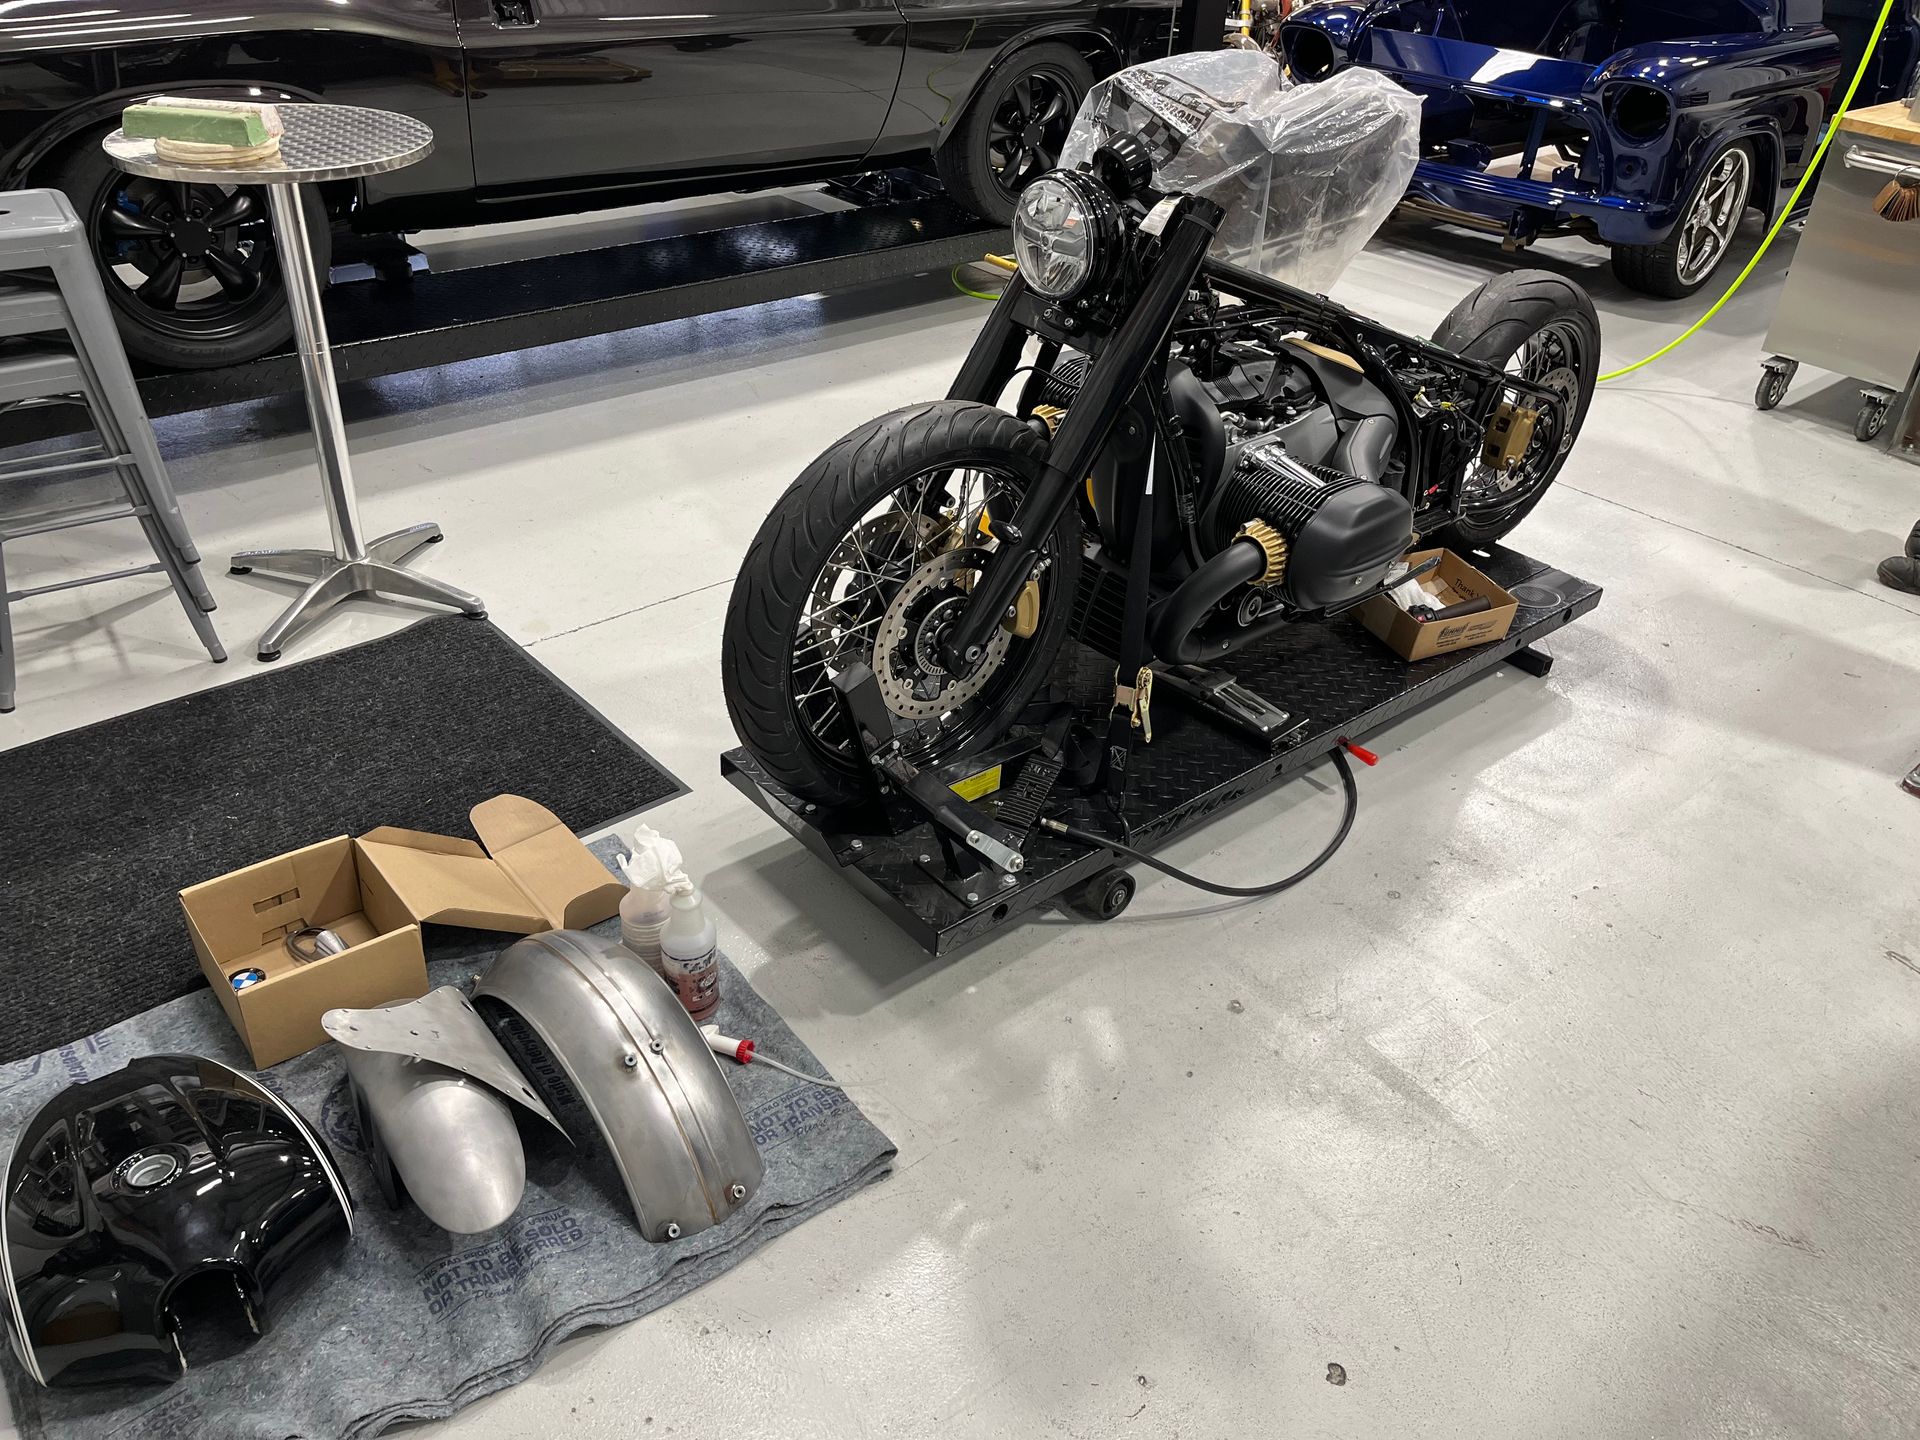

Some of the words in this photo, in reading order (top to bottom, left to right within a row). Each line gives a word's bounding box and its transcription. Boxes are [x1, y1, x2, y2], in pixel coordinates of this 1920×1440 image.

[548, 1075, 577, 1106] Made
[751, 1112, 784, 1133] NOT
[785, 1098, 808, 1113] TO
[813, 1086, 836, 1101] BE
[754, 1129, 779, 1146] OR
[416, 1268, 437, 1286] THIS
[439, 1257, 461, 1269] PAD
[422, 1265, 461, 1302] NOT
[468, 1257, 493, 1272] TO
[498, 1239, 522, 1265] BE
[524, 1217, 578, 1241] SOLD
[428, 1290, 454, 1315] OR
